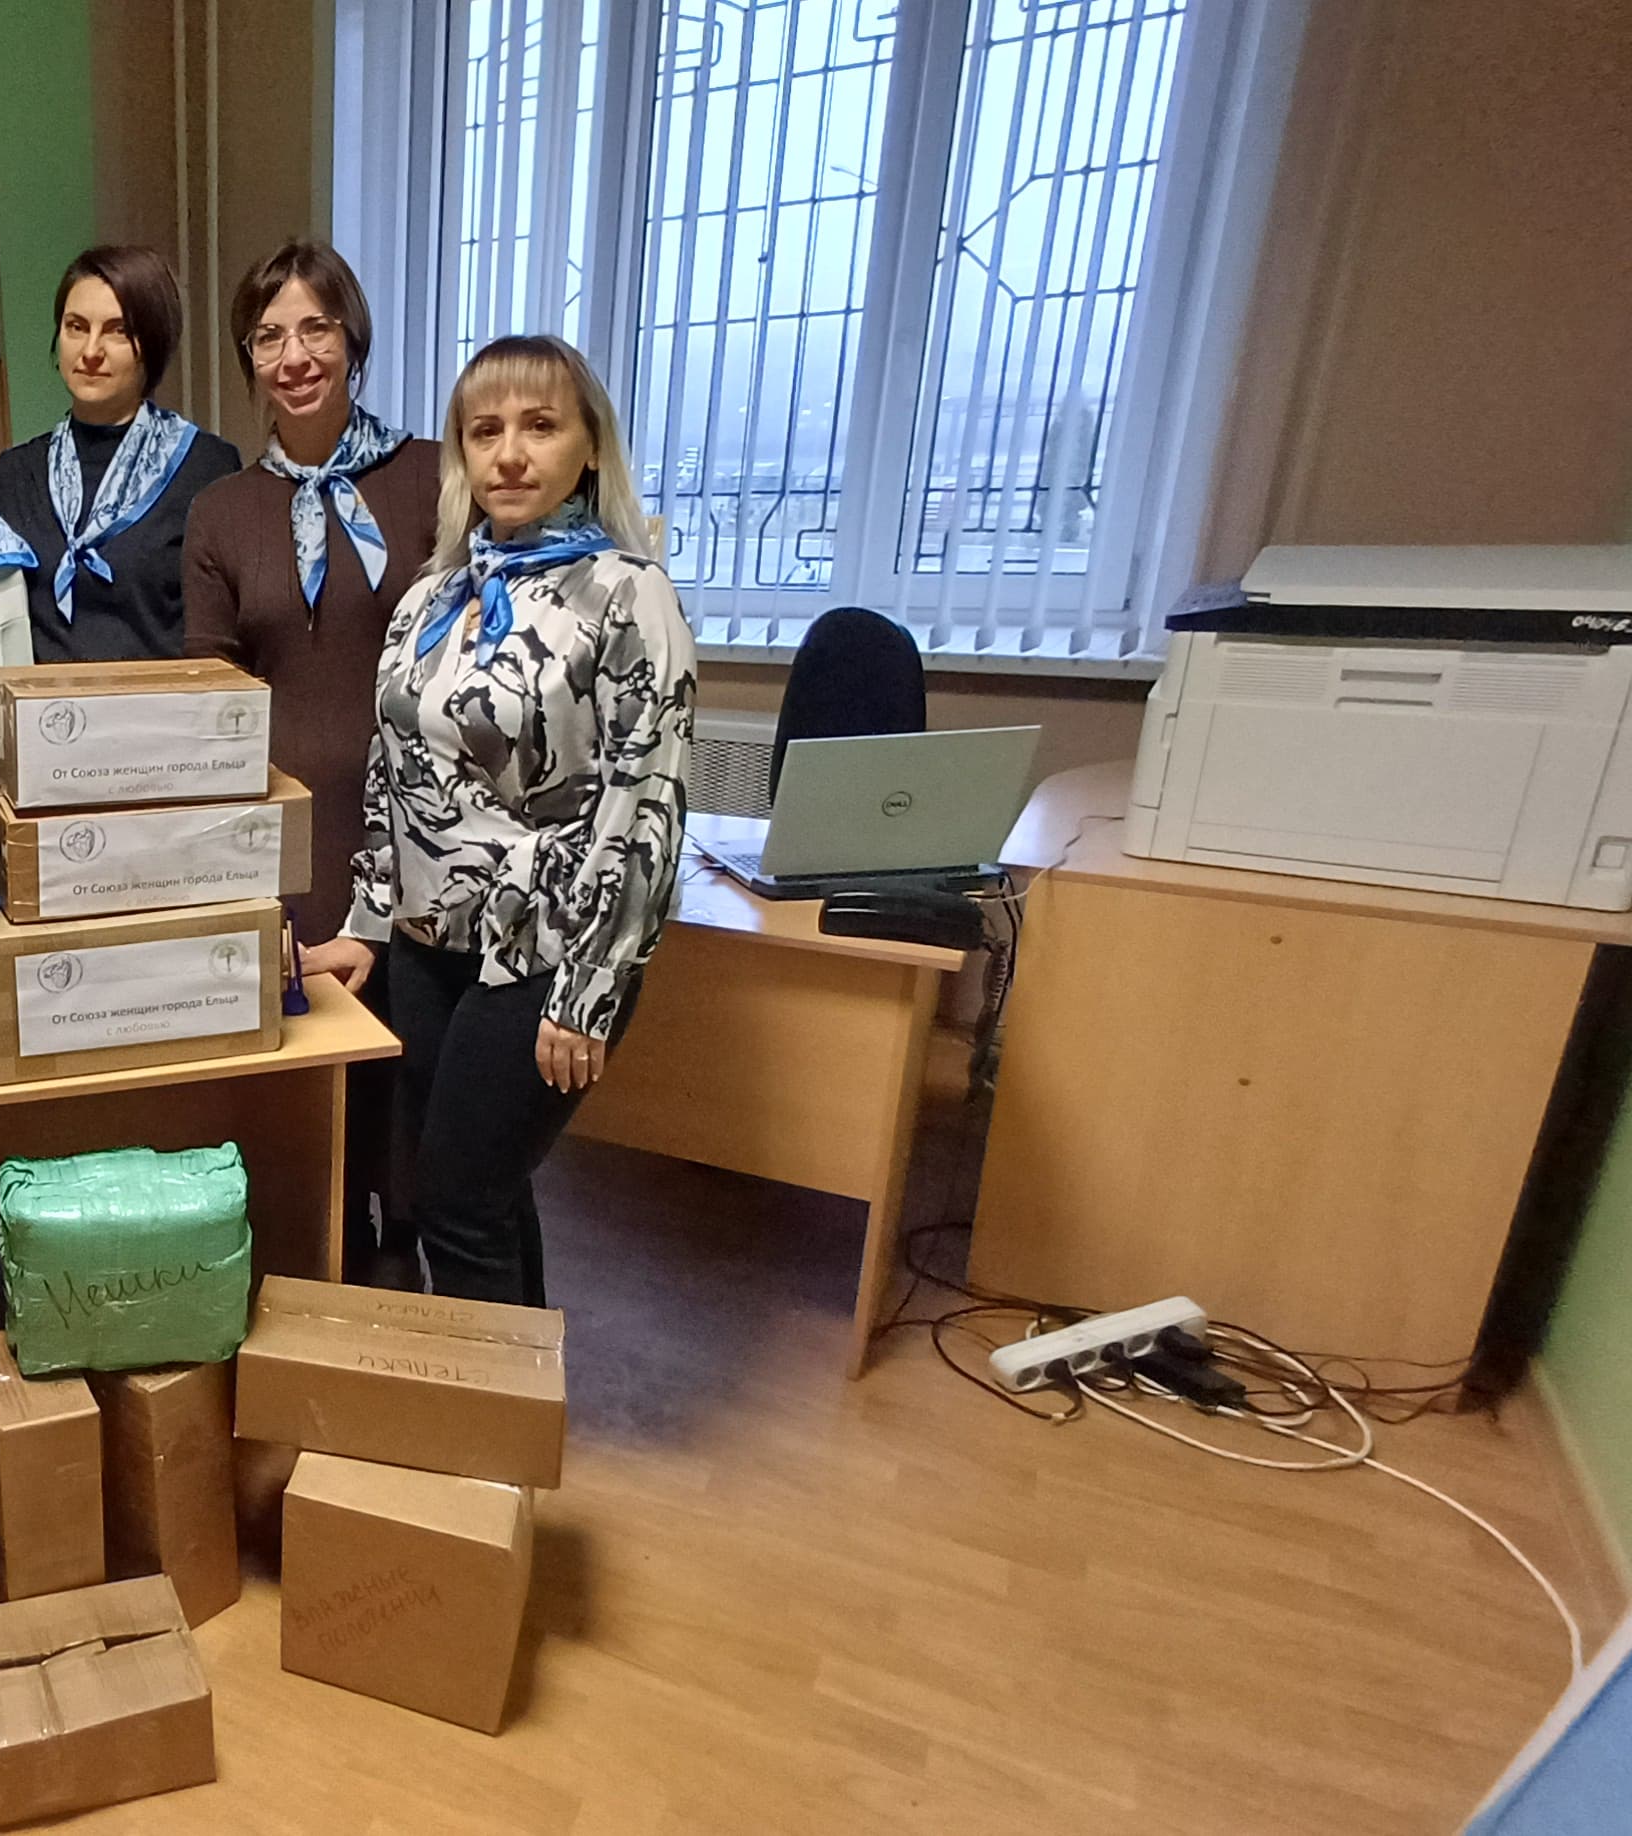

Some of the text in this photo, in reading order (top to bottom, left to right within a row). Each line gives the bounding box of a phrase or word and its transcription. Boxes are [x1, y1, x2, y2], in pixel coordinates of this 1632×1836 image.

[52, 758, 246, 780] От Союза женщин города Ельца
[73, 870, 259, 896] От Союза женщин города Ельца
[52, 993, 240, 1025] От Союза женщин города Ельца
[42, 1260, 214, 1330] Мешки
